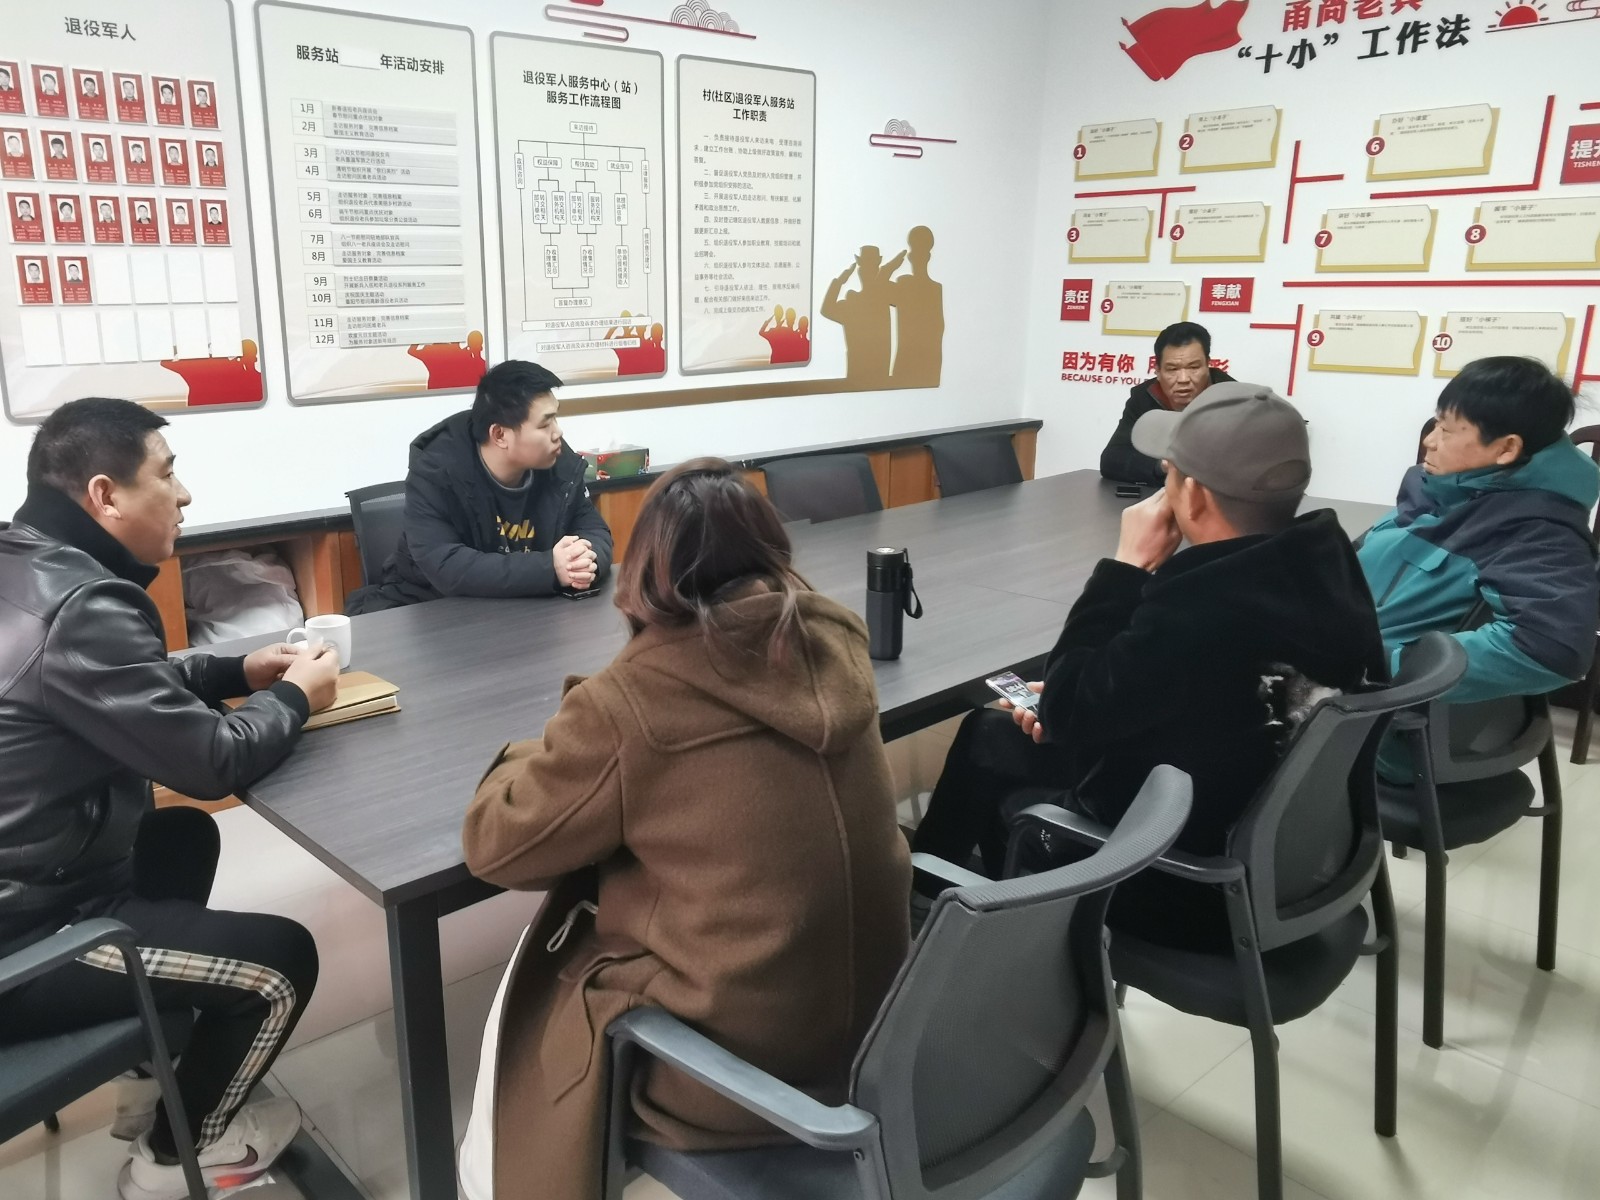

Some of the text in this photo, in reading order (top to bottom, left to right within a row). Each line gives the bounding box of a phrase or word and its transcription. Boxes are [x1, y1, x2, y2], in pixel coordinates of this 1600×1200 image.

[64, 17, 136, 41] 退役军人
[1357, 14, 1471, 60] 工作法
[296, 45, 445, 75] 服务站 年活动安排
[546, 90, 621, 110] 服务工作流程图
[300, 103, 314, 114] 1月
[732, 108, 768, 122] 工作职责
[302, 121, 316, 132] 2月
[304, 148, 318, 158] 3月
[305, 166, 320, 176] 4月
[307, 192, 321, 202] 5月
[308, 208, 322, 219] 6月
[310, 234, 324, 245] 7月
[311, 252, 326, 262] 8月
[313, 276, 328, 287] 9月
[1064, 290, 1090, 304] 责任
[1211, 284, 1242, 300] 奉献
[312, 293, 332, 303] 10月
[314, 318, 333, 328] 11月
[315, 334, 335, 344] 12月
[1062, 352, 1135, 374] 因为有你
[1061, 373, 1141, 386] BECAUSE OF YOU
